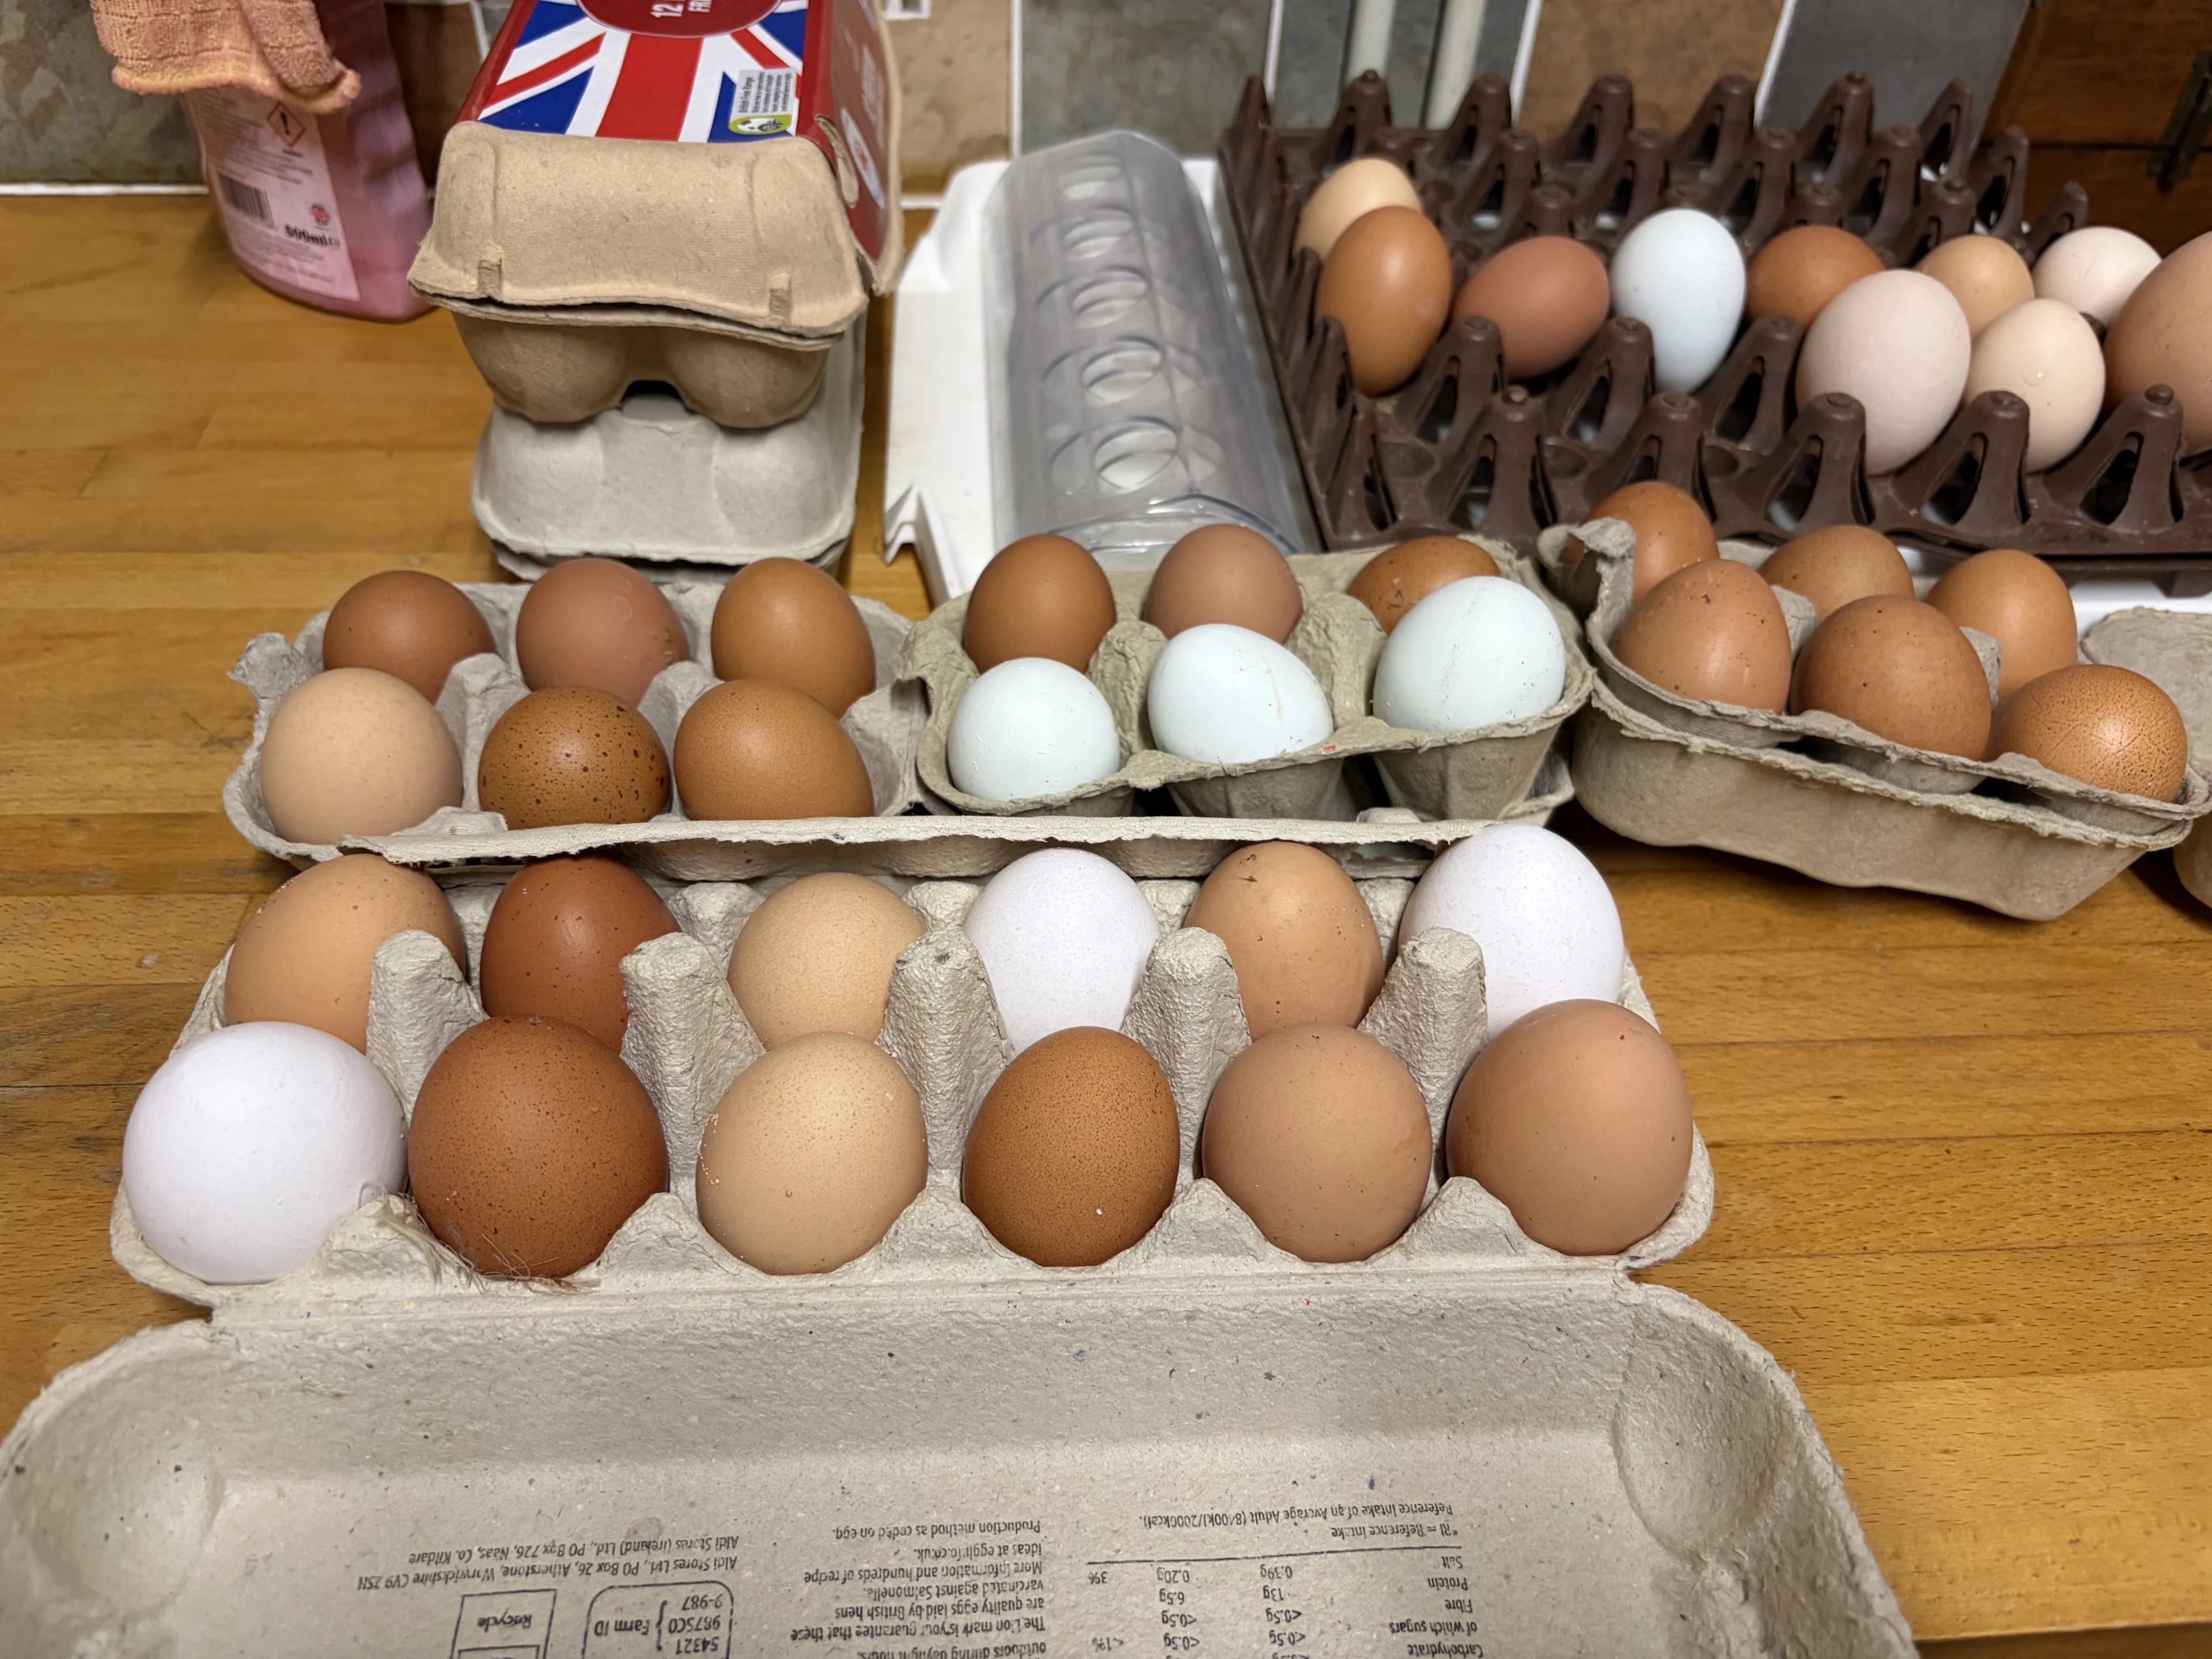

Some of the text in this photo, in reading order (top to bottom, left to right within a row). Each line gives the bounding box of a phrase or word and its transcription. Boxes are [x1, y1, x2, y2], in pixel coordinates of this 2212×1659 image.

[650, 3, 684, 18] 12
[688, 0, 712, 13] FR
[1283, 1506, 1327, 1521] Average
[1331, 1505, 1344, 1517] an
[1347, 1507, 1358, 1520] of
[1361, 1503, 1396, 1517] Intake
[1399, 1502, 1453, 1516] Reference
[1249, 1510, 1280, 1524] Adult
[832, 1520, 1040, 1540] Production method as coded on egg.
[1331, 1526, 1366, 1541] Intake
[1369, 1524, 1423, 1537] Reference
[570, 1543, 586, 1556] PO
[619, 1539, 672, 1555] (Ireland)
[675, 1537, 713, 1551] Stores
[715, 1536, 738, 1549] Aldi
[1012, 1543, 1041, 1557] ideas
[408, 1550, 452, 1566] Kildare
[456, 1549, 472, 1563] Co.
[476, 1546, 509, 1560] Naas,
[514, 1544, 540, 1558] 726,
[543, 1543, 566, 1558] Box
[997, 1545, 1009, 1557] at
[501, 1563, 571, 1578] Atherstone,
[575, 1561, 593, 1577] 26,
[594, 1562, 620, 1575] Box
[623, 1561, 639, 1575] PO
[673, 1558, 710, 1572] Stores
[714, 1555, 737, 1571] Aldi
[1013, 1561, 1042, 1575] More
[1088, 1555, 1463, 1585] Salt 0.39g 0.20g 3%
[385, 1573, 410, 1589] CV9
[413, 1567, 495, 1586] Warwickshire
[804, 1569, 839, 1585] recipe
[841, 1570, 854, 1584] of
[858, 1567, 913, 1584] hundreds
[916, 1567, 938, 1581] and
[357, 1575, 382, 1590] 2SH
[935, 1581, 979, 1599] against
[863, 1585, 933, 1601] Salmonella.
[1158, 1577, 1468, 1605] Protein 13g 6.5g
[681, 1594, 723, 1610] 9-987
[835, 1596, 1044, 1621] are quality eggs laid by British hens
[478, 1607, 532, 1633] Recycle
[1161, 1599, 1473, 1628] Fibre <0.5g <0.5g
[594, 1620, 609, 1638] ID
[614, 1619, 650, 1636] Farm
[855, 1621, 916, 1638] guarantee
[963, 1622, 993, 1637] mark
[996, 1619, 1021, 1634] Lion
[1024, 1616, 1045, 1632] The
[1389, 1618, 1427, 1634] sugars
[1429, 1621, 1464, 1636] which
[1467, 1621, 1478, 1637] of
[790, 1627, 823, 1642] these
[827, 1626, 852, 1641] that
[1269, 1630, 1306, 1647] <0.5g
[676, 1637, 719, 1654] 54321
[1163, 1633, 1200, 1650] <0.5g
[1407, 1641, 1483, 1658] Carbohydrate
